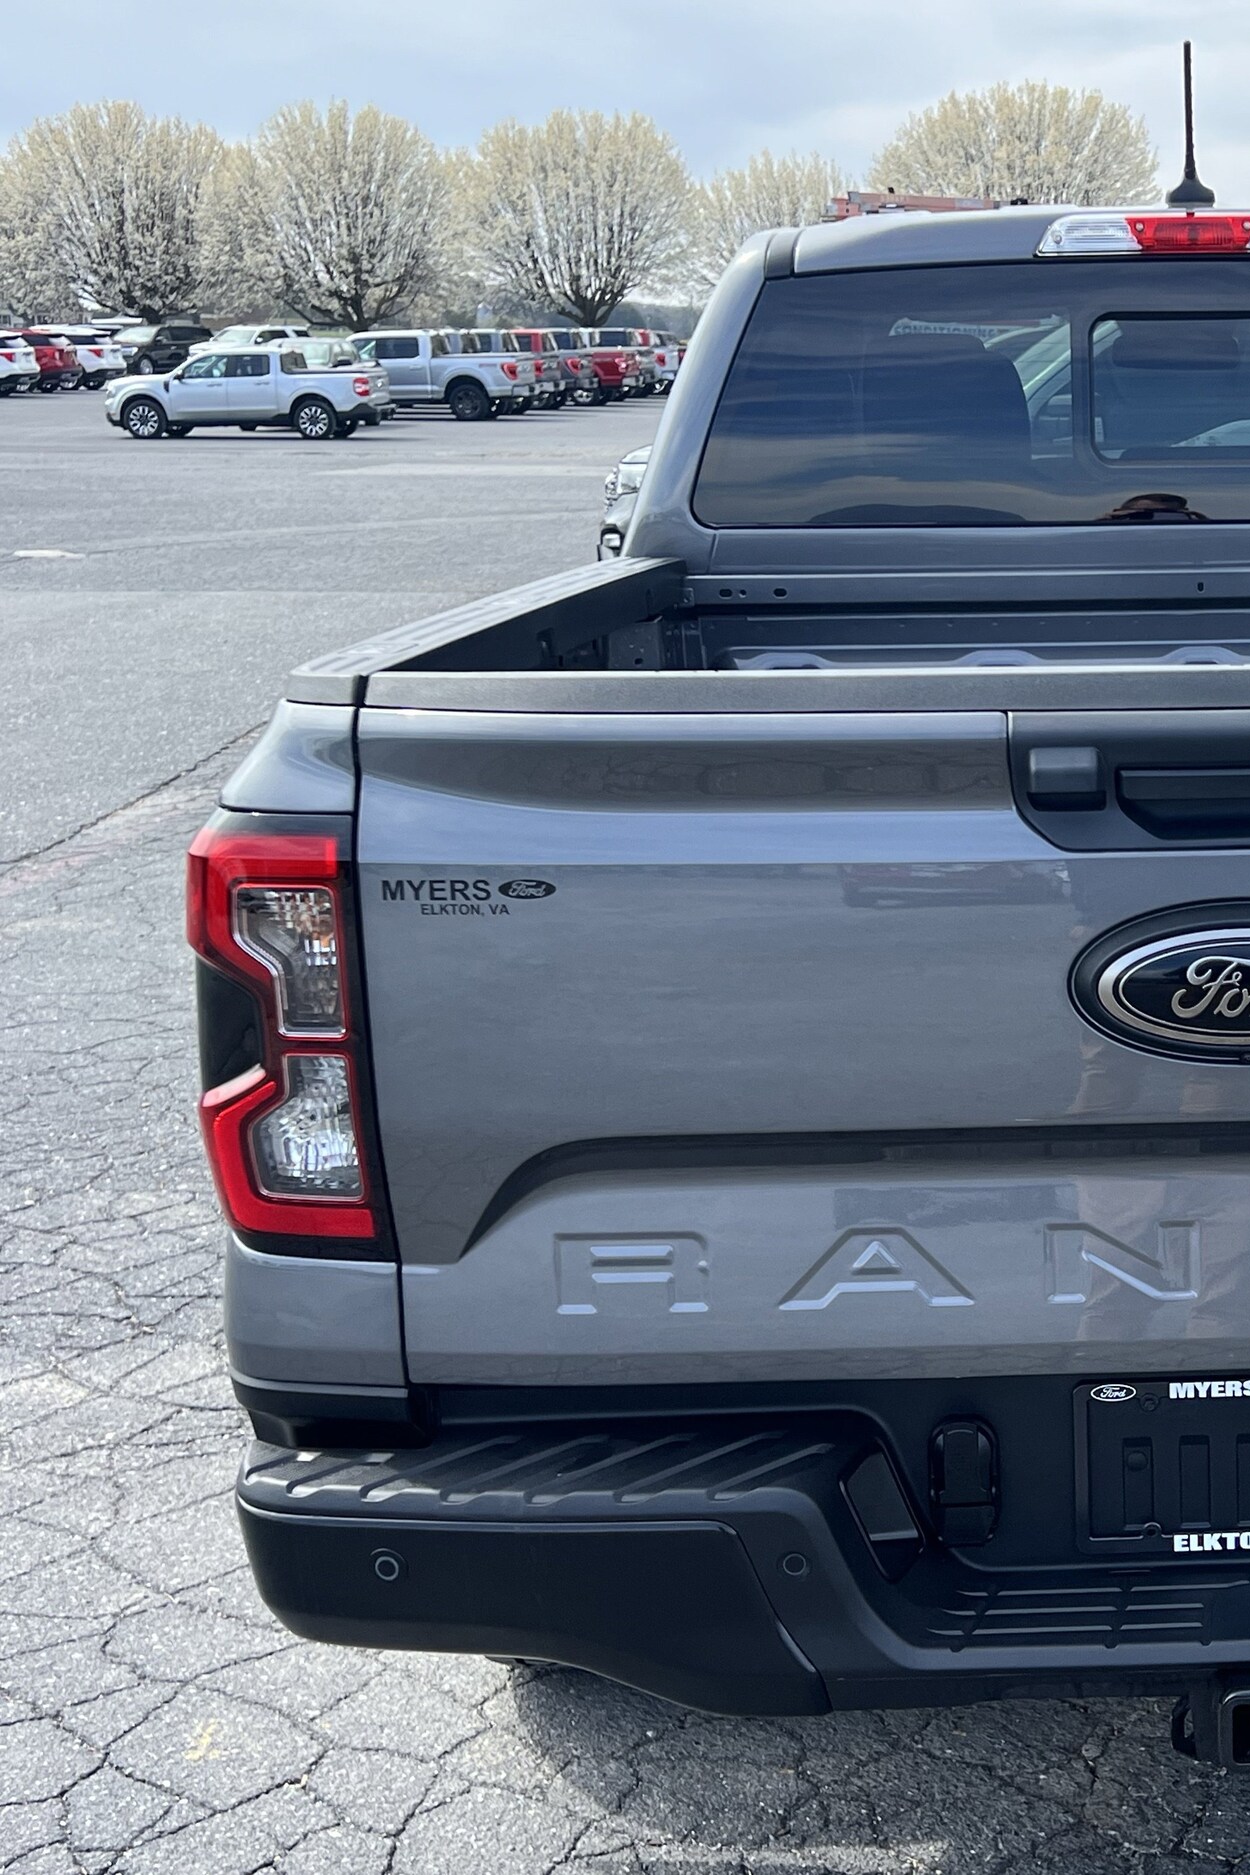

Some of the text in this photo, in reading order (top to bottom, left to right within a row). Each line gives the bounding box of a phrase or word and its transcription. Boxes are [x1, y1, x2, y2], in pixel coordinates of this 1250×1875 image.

[381, 880, 546, 901] MYERS Ford
[420, 904, 510, 917] ELKTON, VA
[1100, 1386, 1126, 1398] Ford
